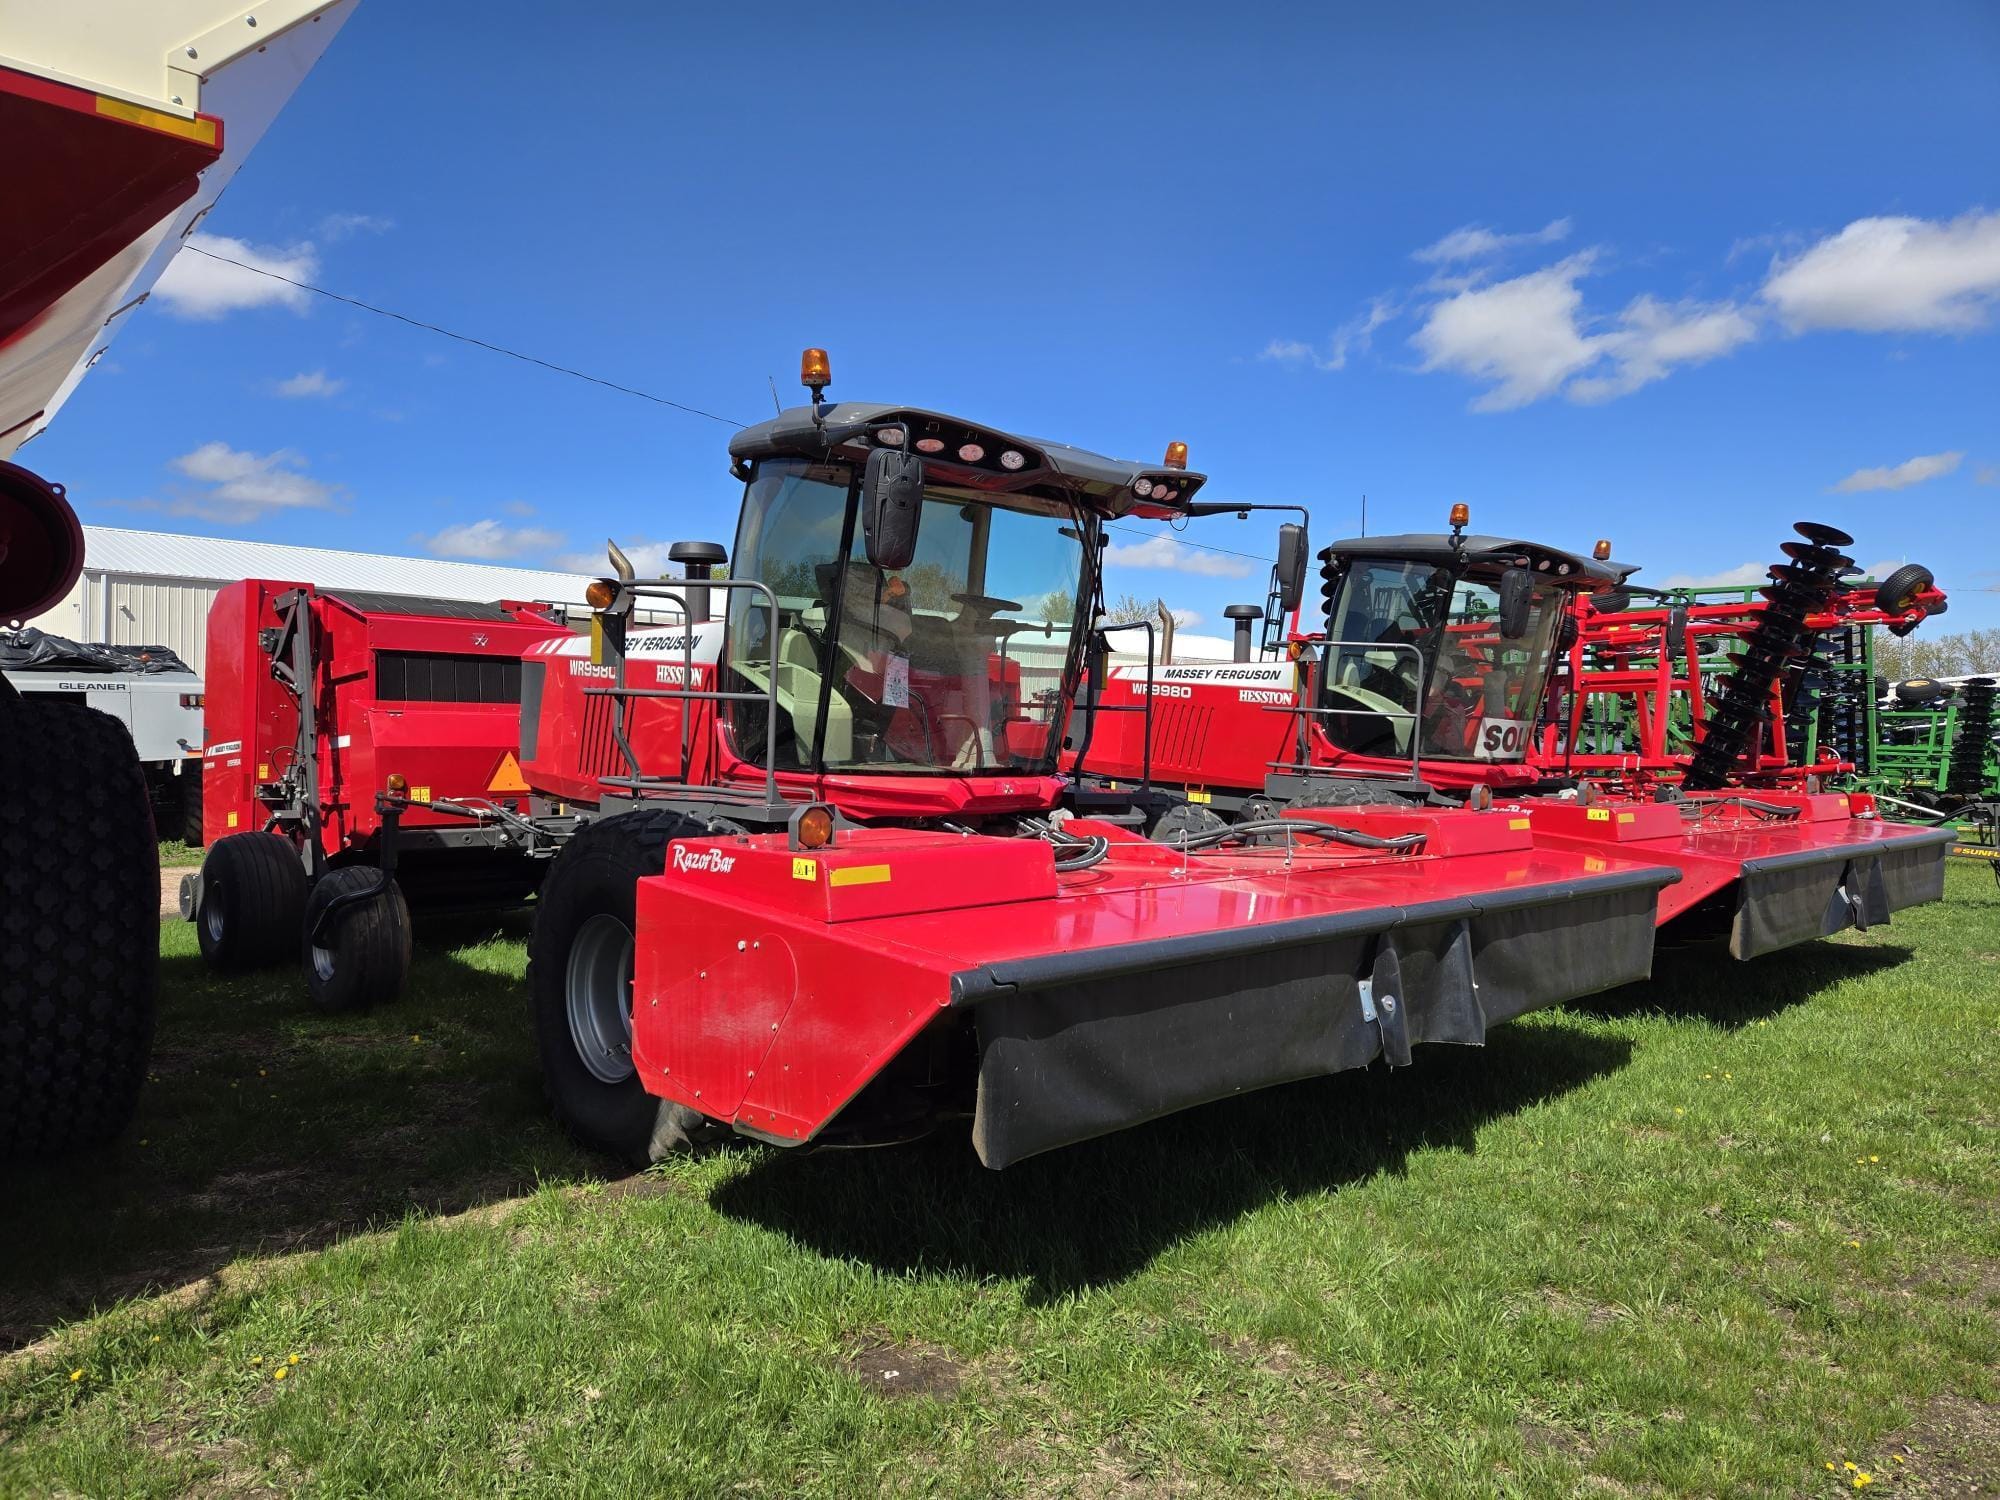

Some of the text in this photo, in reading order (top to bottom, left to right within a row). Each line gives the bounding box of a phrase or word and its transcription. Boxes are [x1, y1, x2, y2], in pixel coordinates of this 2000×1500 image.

[1164, 669, 1281, 680] MASSEY FERGUSON
[58, 682, 126, 691] GLEANER
[1239, 689, 1293, 706] HESSTON
[672, 844, 736, 873] RazorBar
